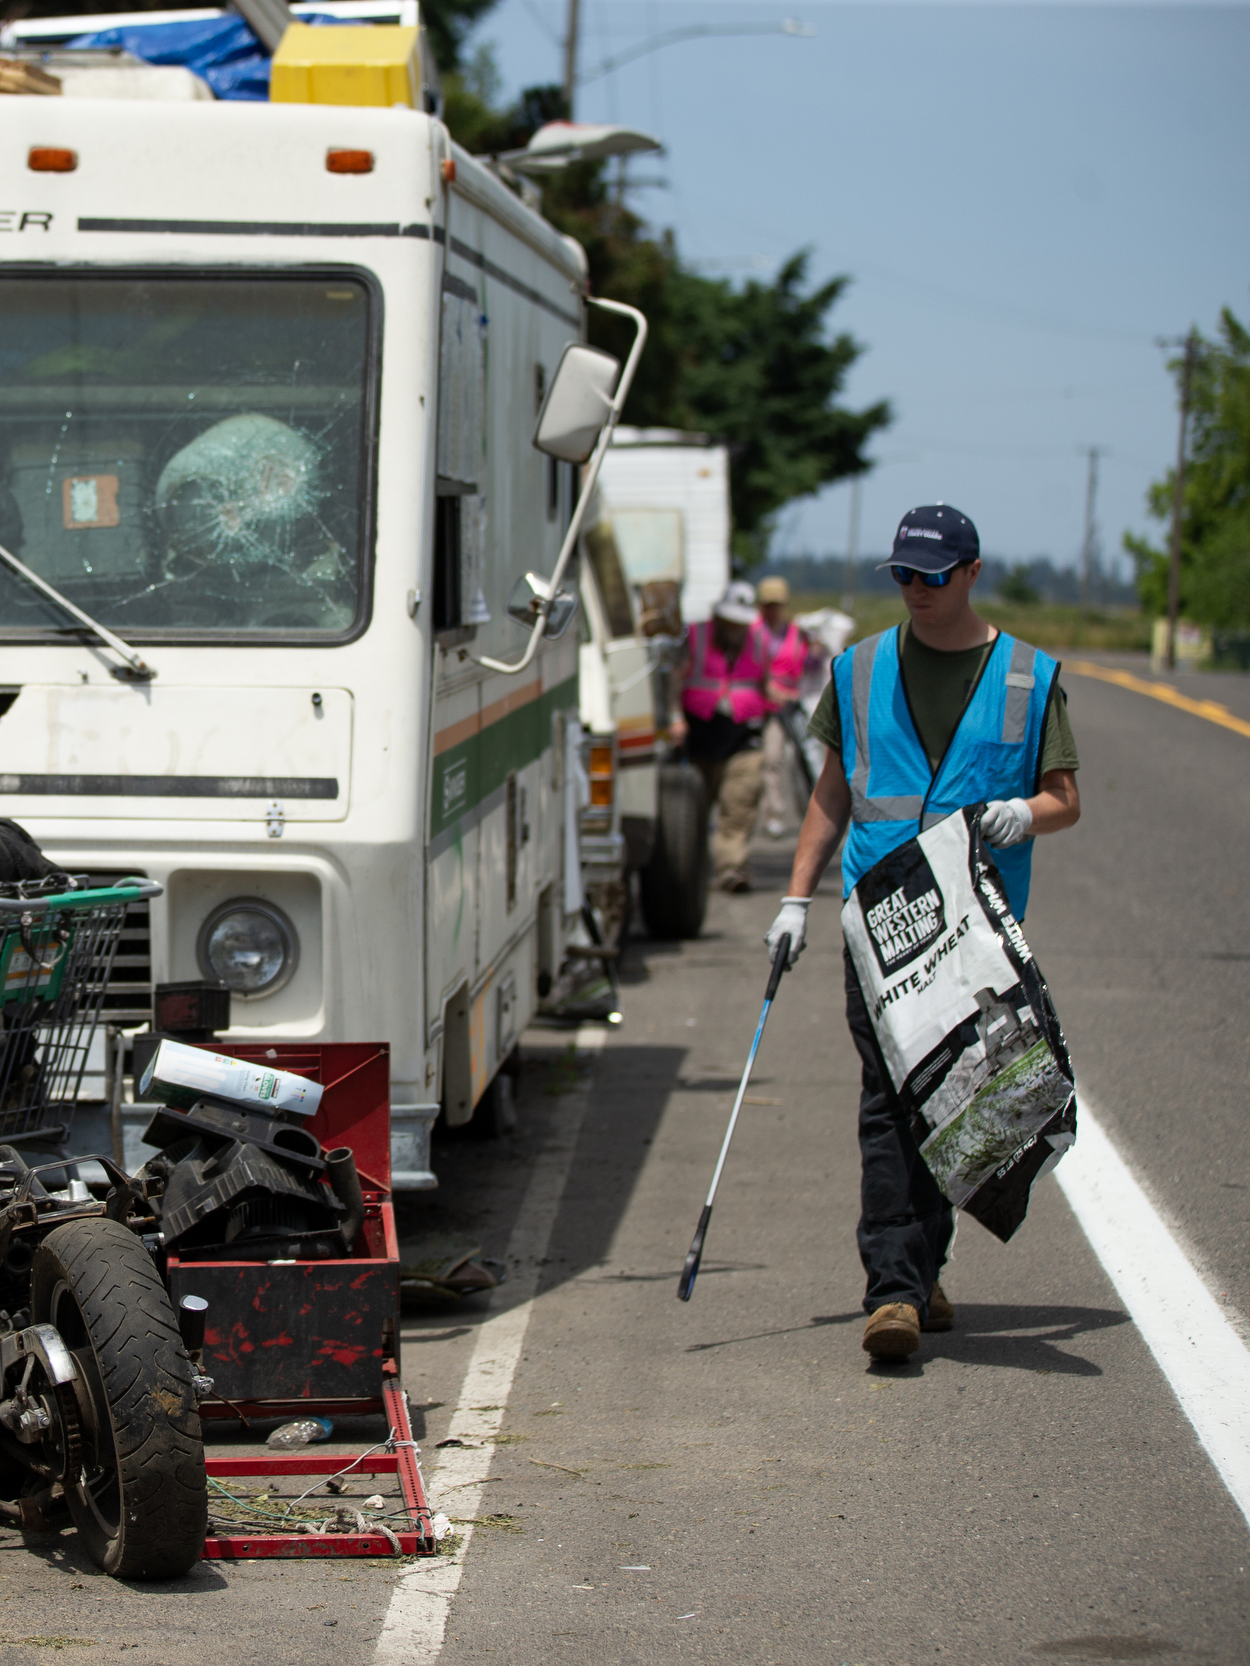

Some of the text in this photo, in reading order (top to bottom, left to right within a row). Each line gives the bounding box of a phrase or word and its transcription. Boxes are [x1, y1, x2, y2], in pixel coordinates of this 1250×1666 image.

[866, 886, 908, 929] GREAT
[871, 888, 940, 945] WESTERN
[879, 911, 938, 963] MALTING
[1000, 914, 1033, 964] WHITE
[873, 914, 969, 1021] WHITE WHEAT
[917, 971, 936, 995] MALT
[260, 1073, 271, 1099] GLOVES
